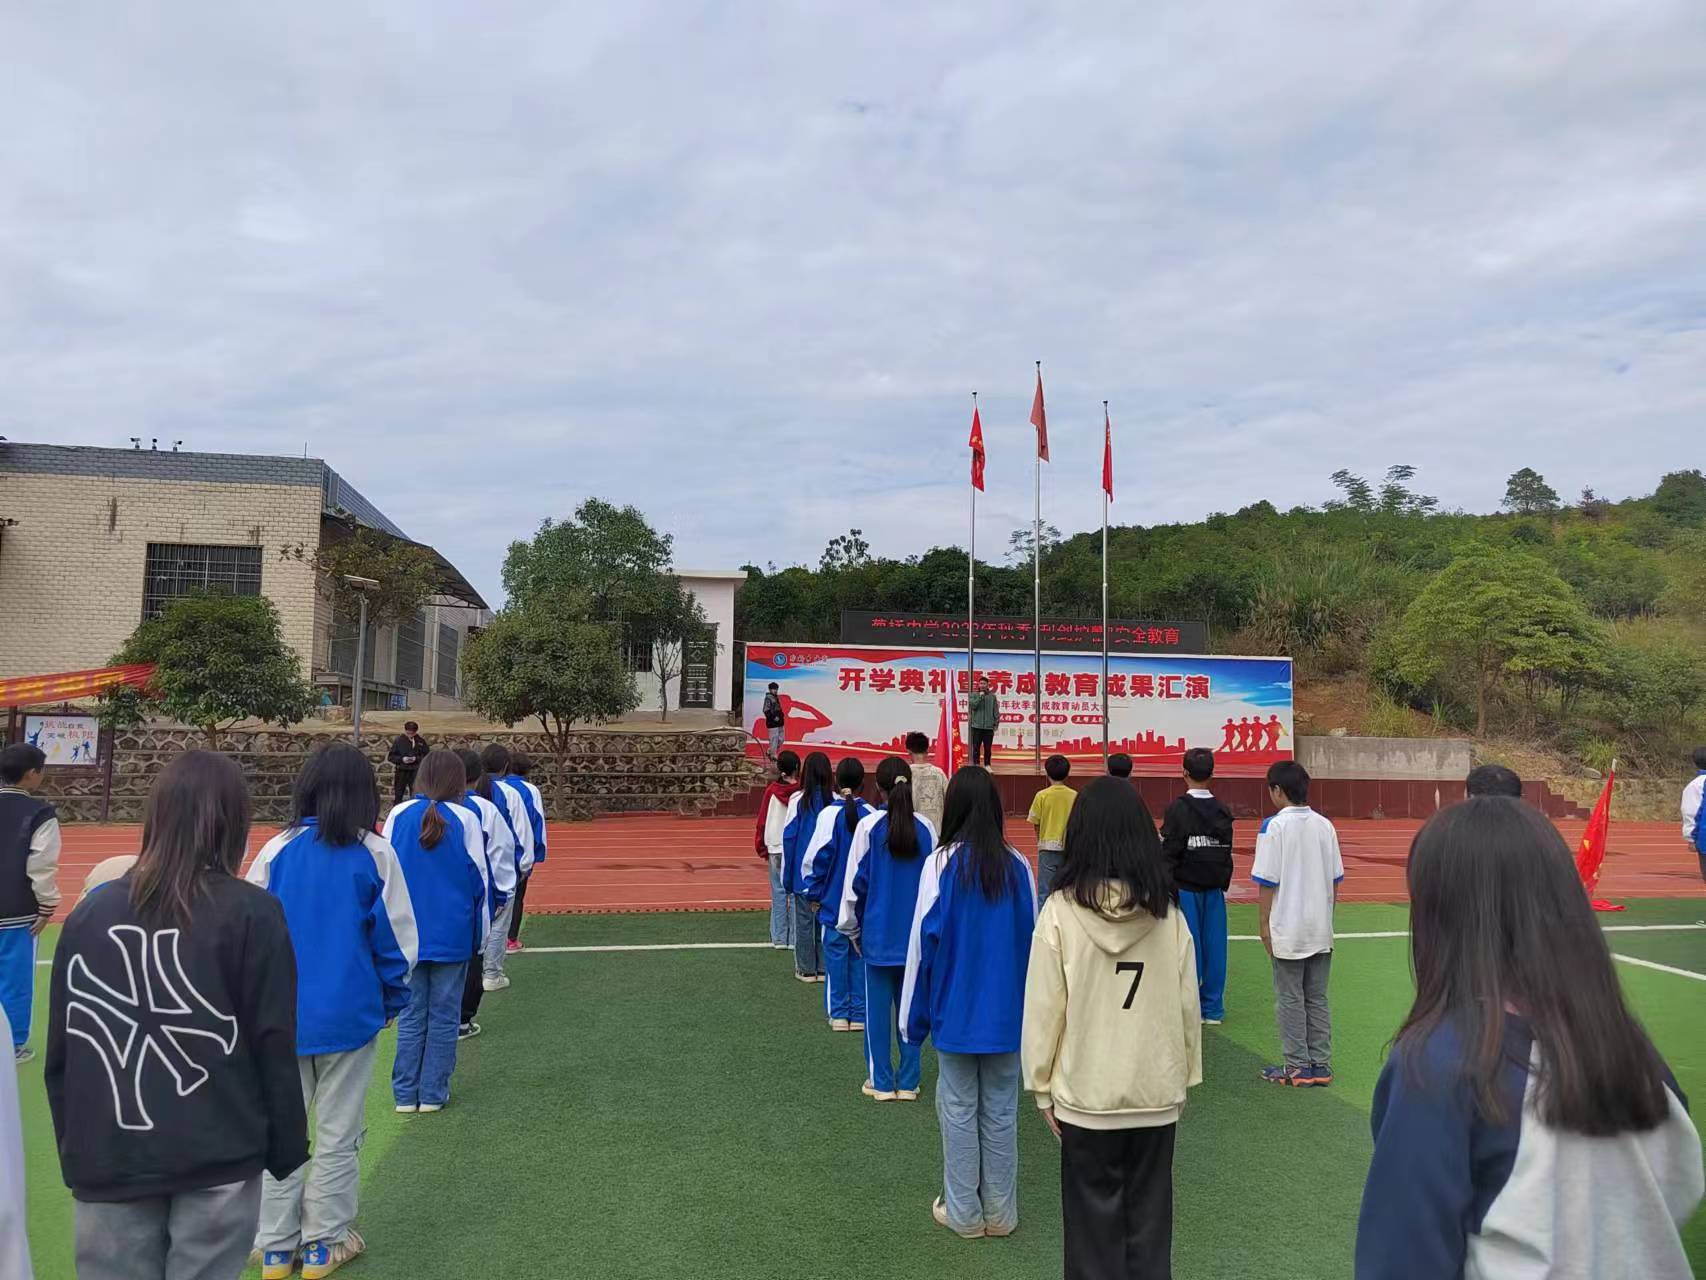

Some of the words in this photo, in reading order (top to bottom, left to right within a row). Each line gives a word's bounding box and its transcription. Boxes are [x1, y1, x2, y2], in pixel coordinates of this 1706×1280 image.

[838, 667, 1210, 699] 开学典礼暨养成教育成果汇演
[1115, 962, 1144, 1010] 7
